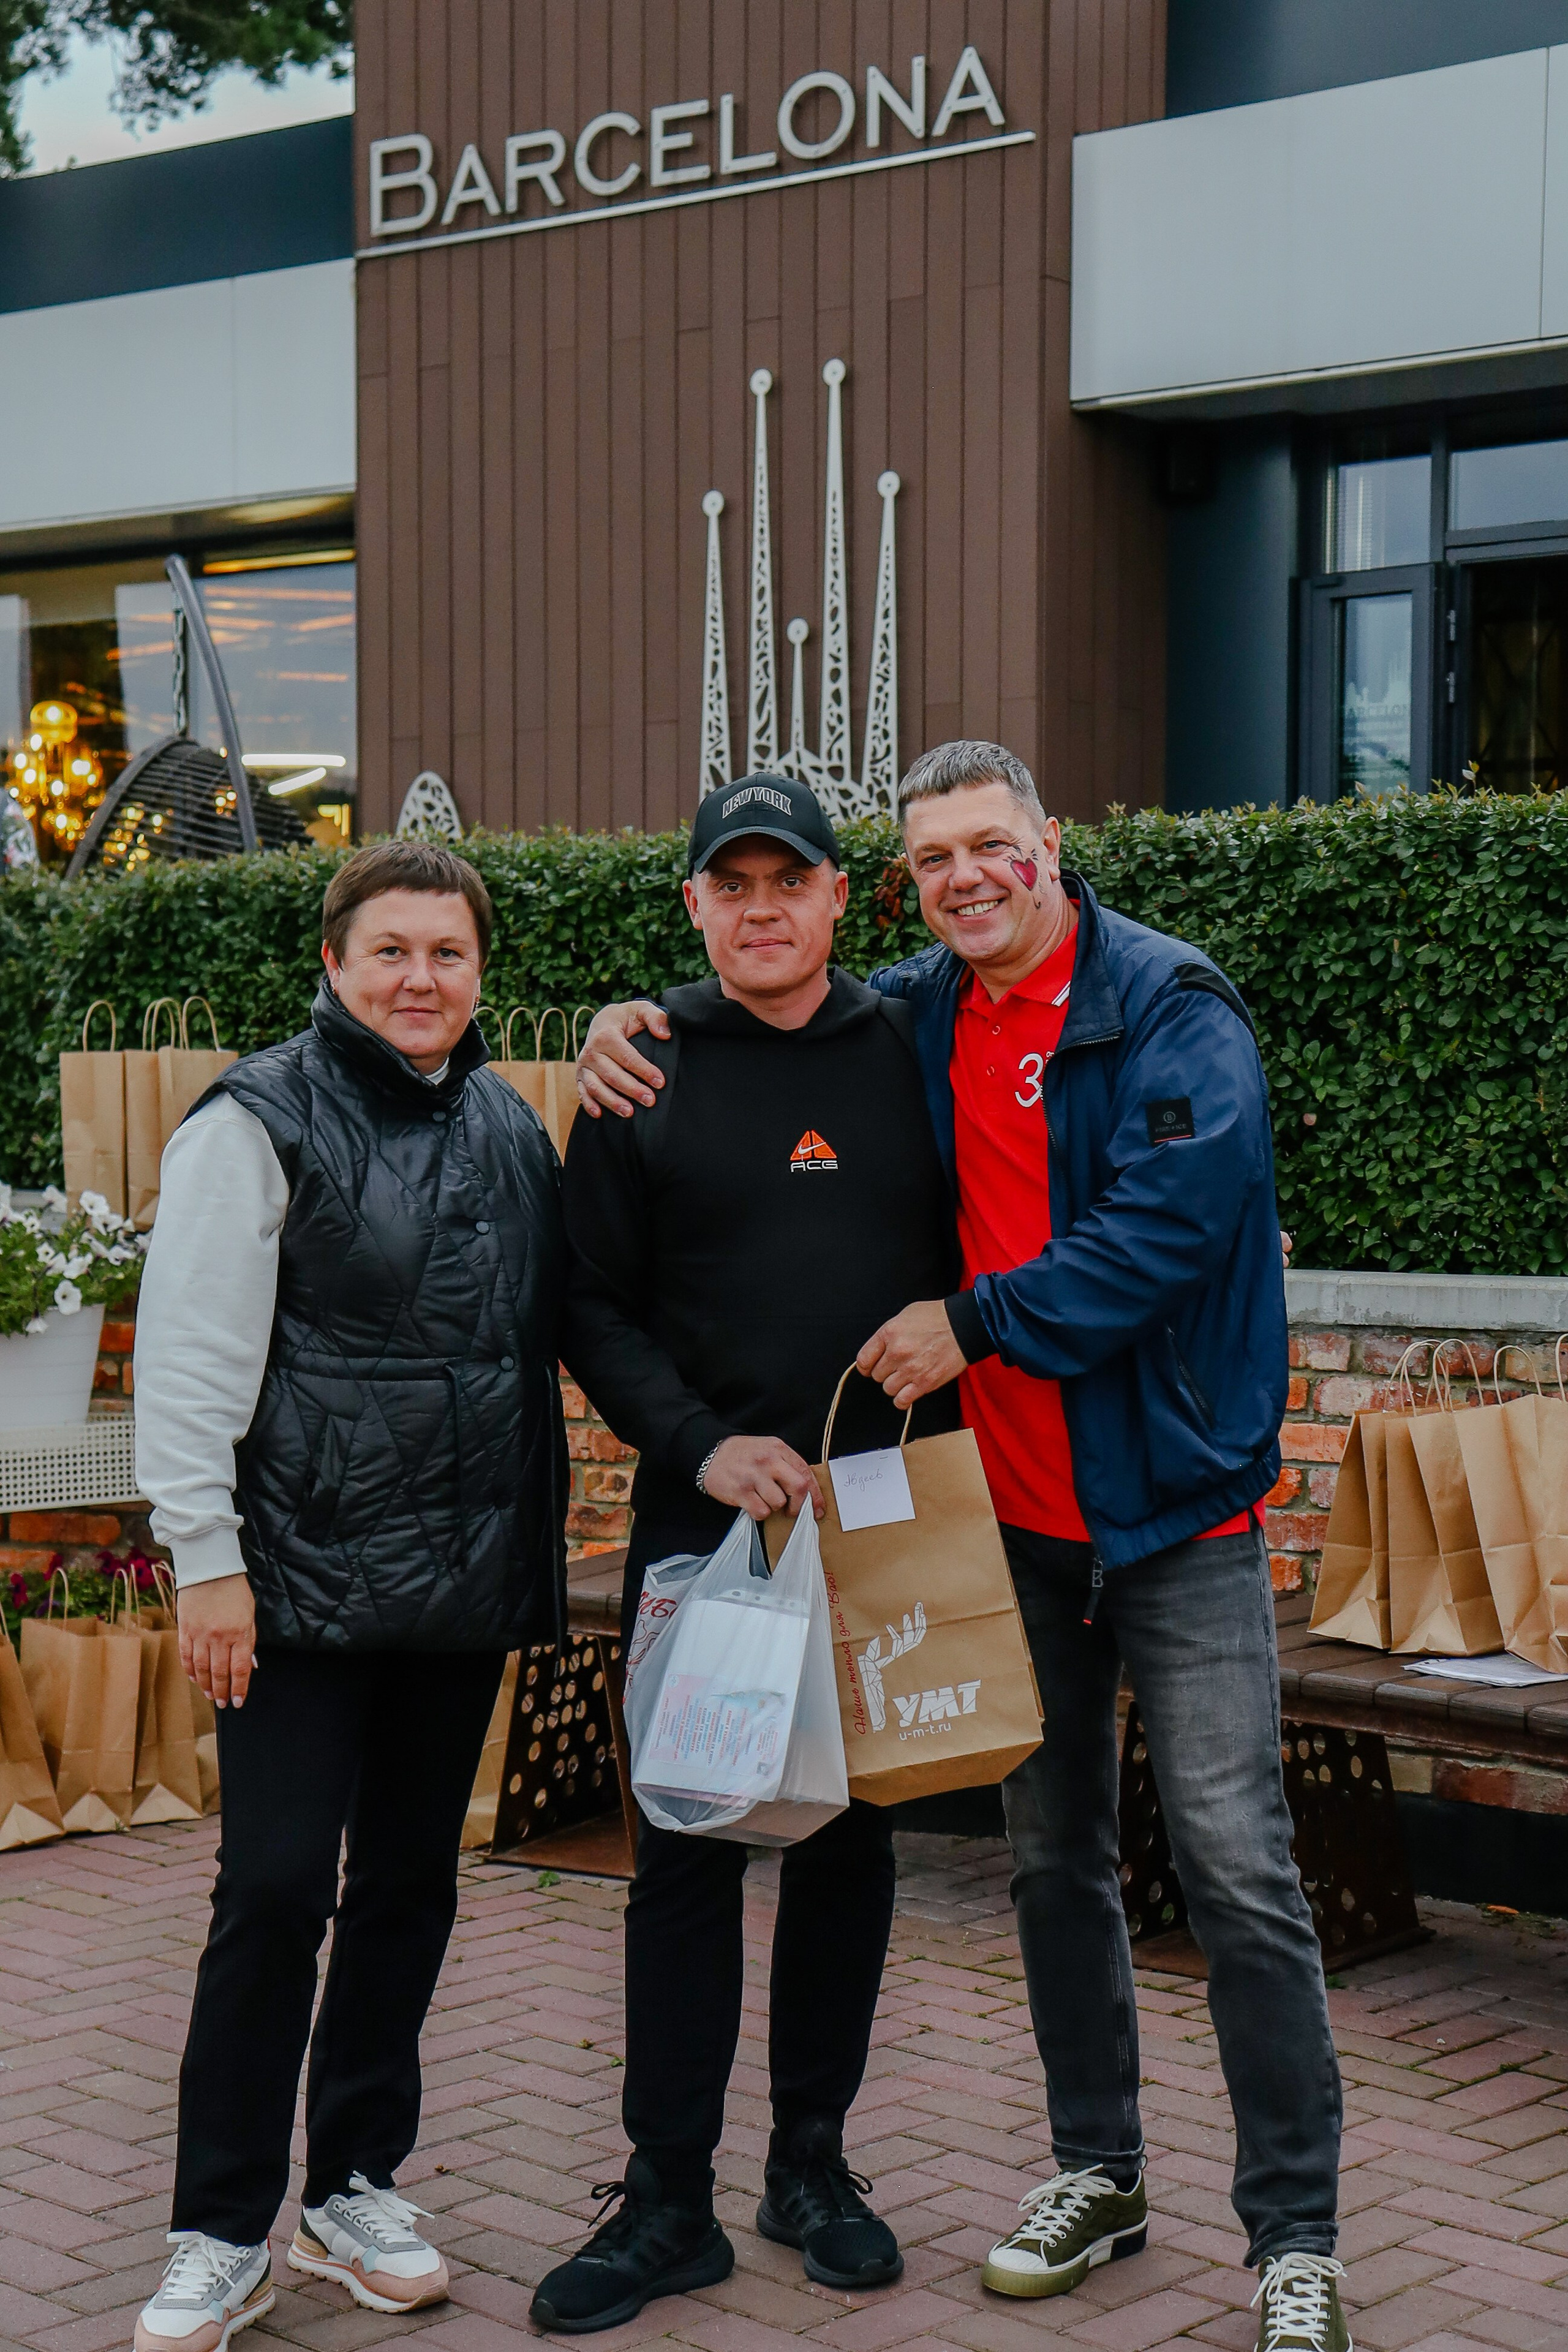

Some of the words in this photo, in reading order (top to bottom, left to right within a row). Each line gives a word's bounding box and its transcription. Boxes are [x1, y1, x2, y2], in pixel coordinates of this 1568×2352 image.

[369, 45, 1006, 238] BARCELONA
[722, 787, 753, 819] NEW
[752, 786, 792, 816] YORK
[790, 1160, 839, 1173] ACG
[836, 1611, 851, 1637] для
[842, 1642, 857, 1684] тепло
[852, 1688, 867, 1735] Наше
[892, 1679, 981, 1728] УМТ
[899, 1722, 952, 1741] u-m-t.ru
